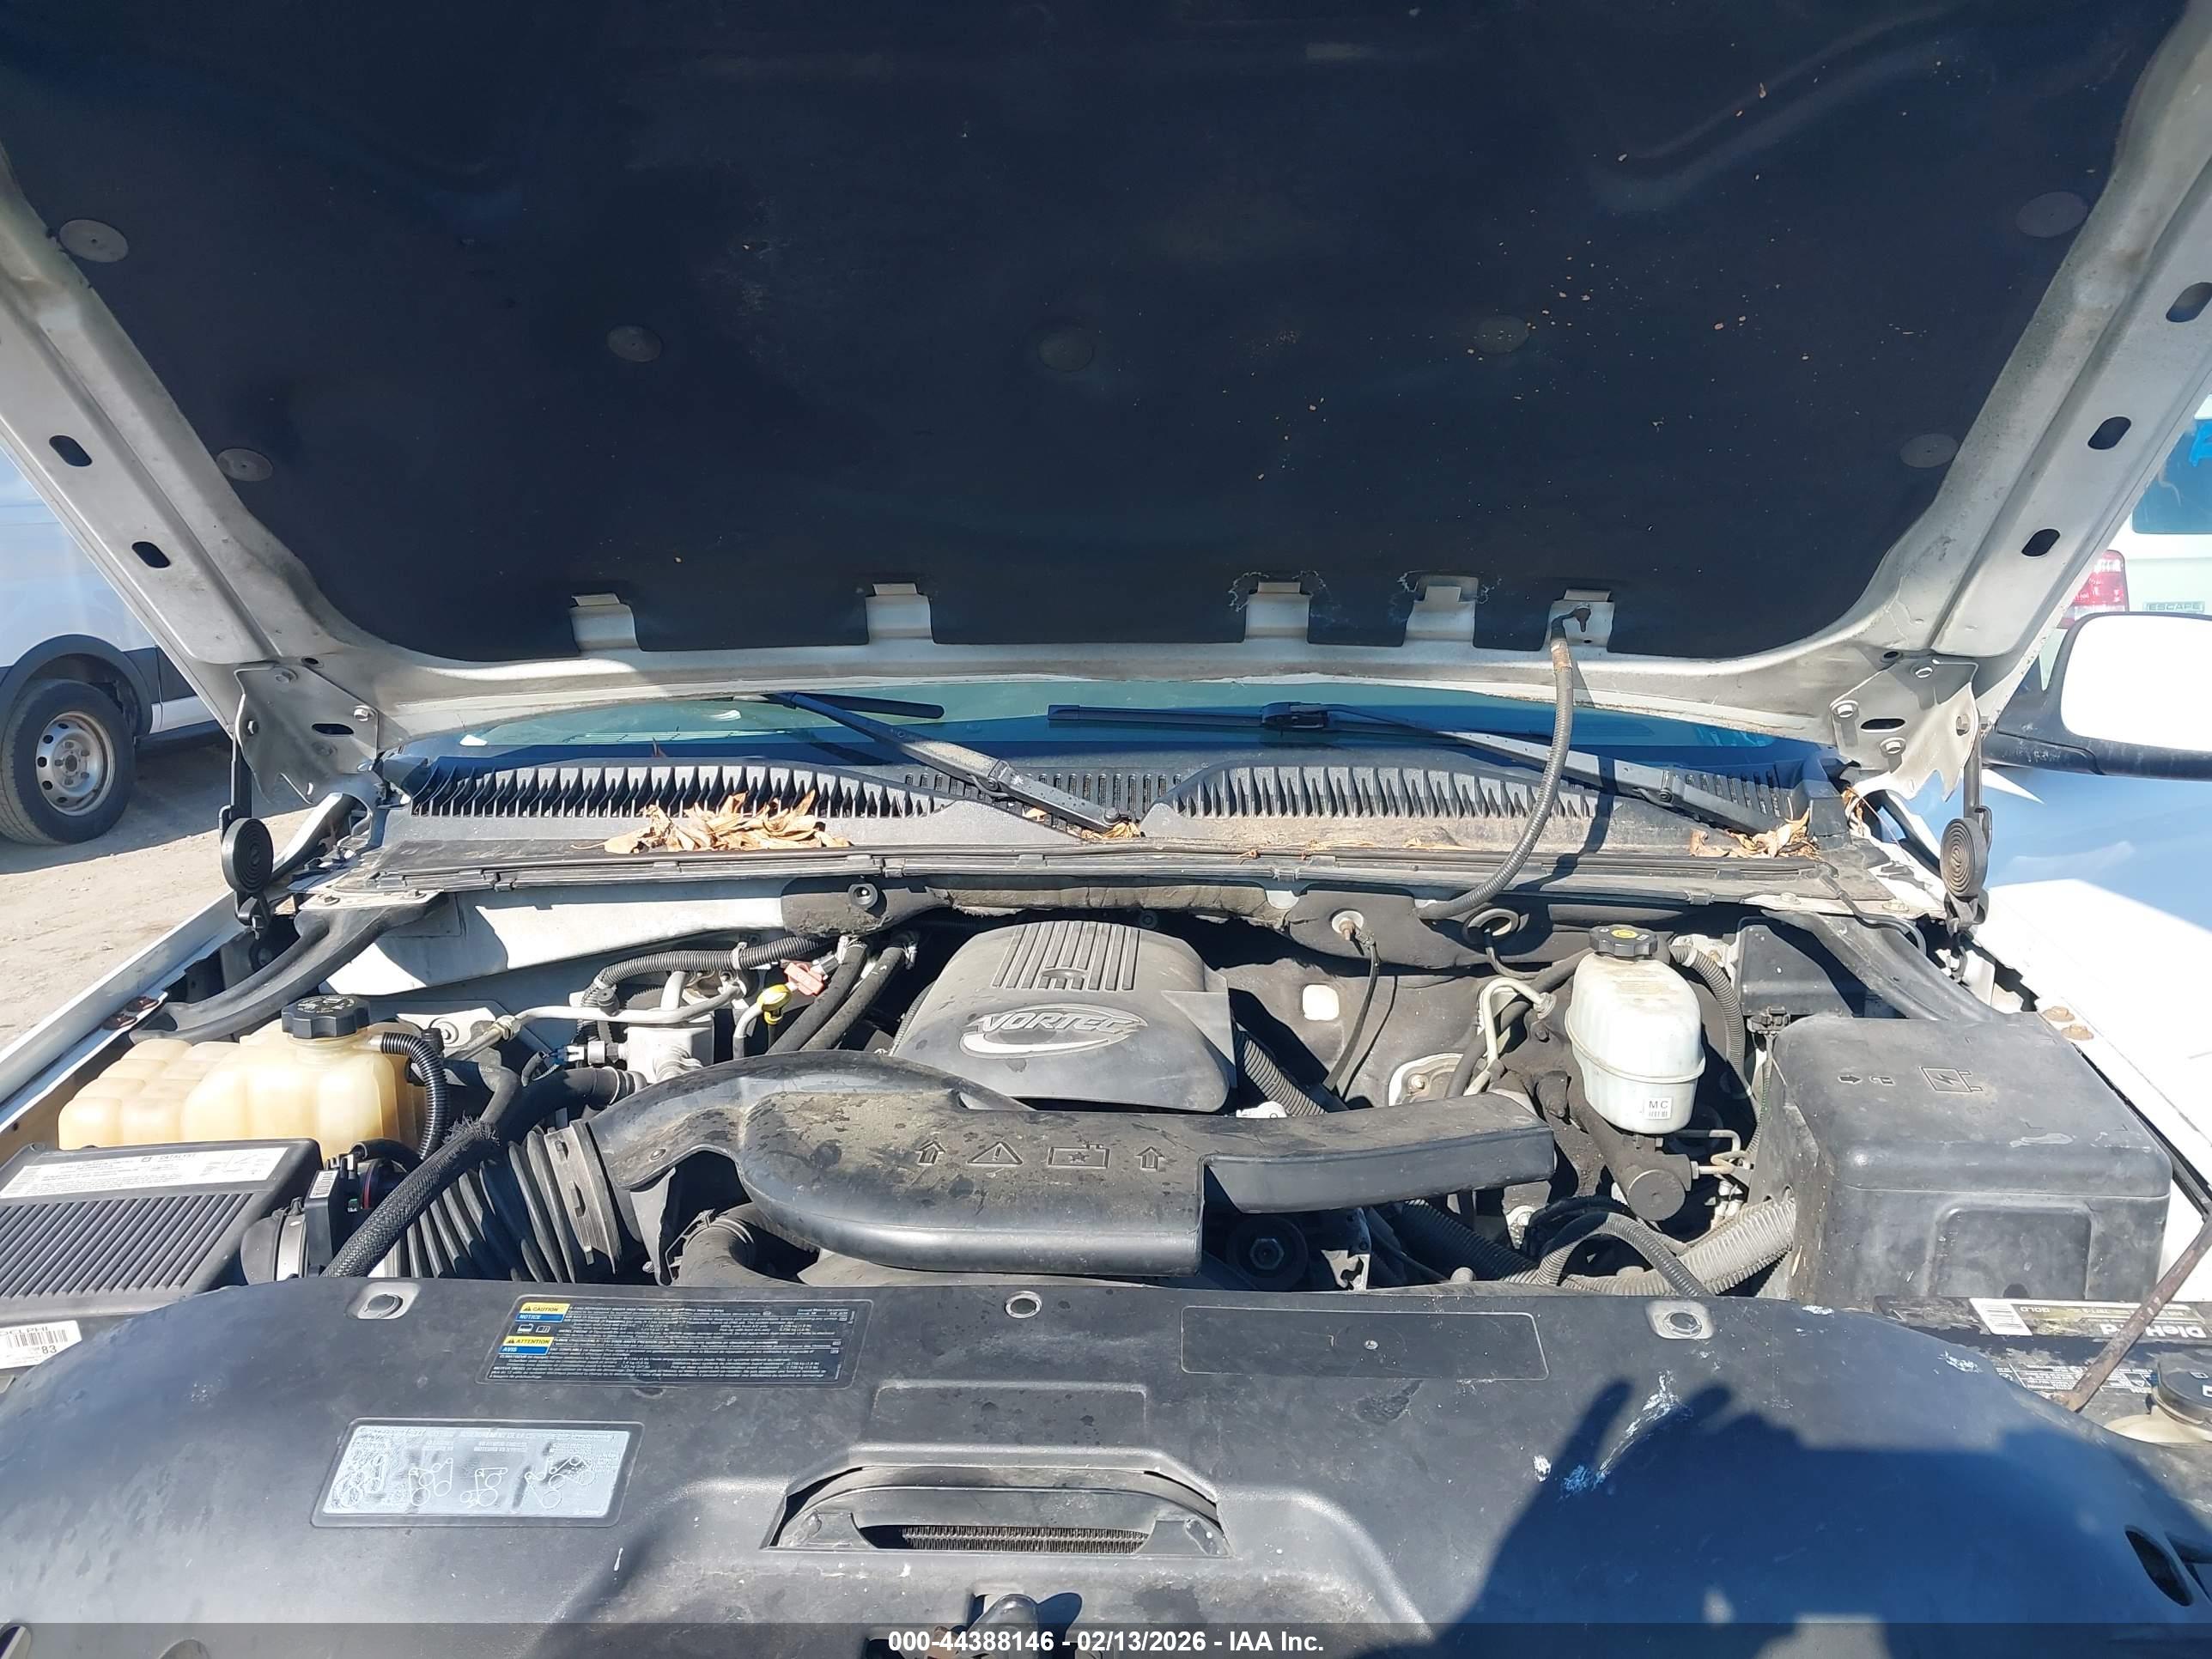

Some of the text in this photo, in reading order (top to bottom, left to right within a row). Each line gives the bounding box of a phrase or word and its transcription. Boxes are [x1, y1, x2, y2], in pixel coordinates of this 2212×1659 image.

[2148, 603, 2201, 611] ESCAPE
[980, 1012, 1135, 1034] VORTEC
[41, 1345, 58, 1354] 83
